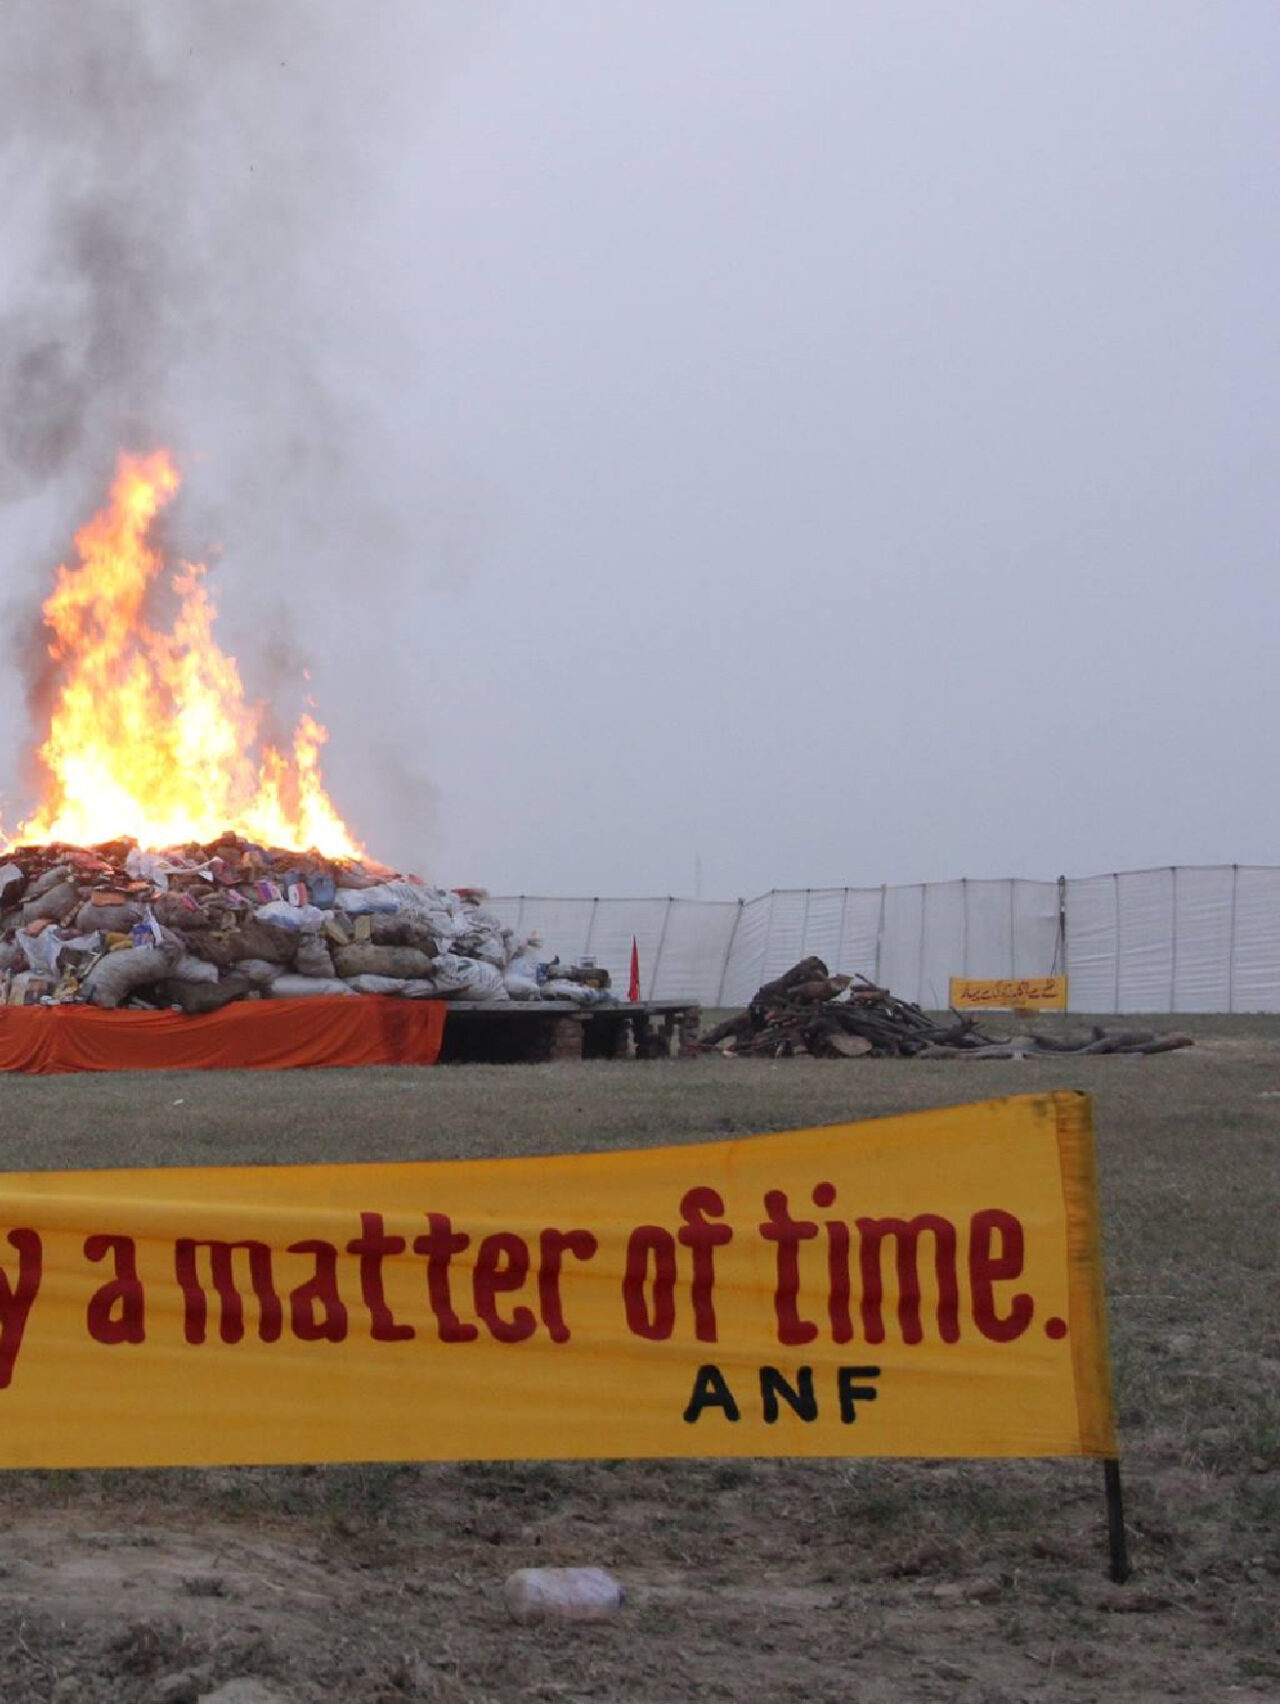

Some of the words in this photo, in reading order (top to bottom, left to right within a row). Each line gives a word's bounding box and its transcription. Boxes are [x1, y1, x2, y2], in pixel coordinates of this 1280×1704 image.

[84, 1234, 145, 1344] a
[175, 1213, 598, 1344] matter
[622, 1187, 733, 1343] of
[760, 1182, 1068, 1346] time.
[683, 1364, 881, 1424] ANF
